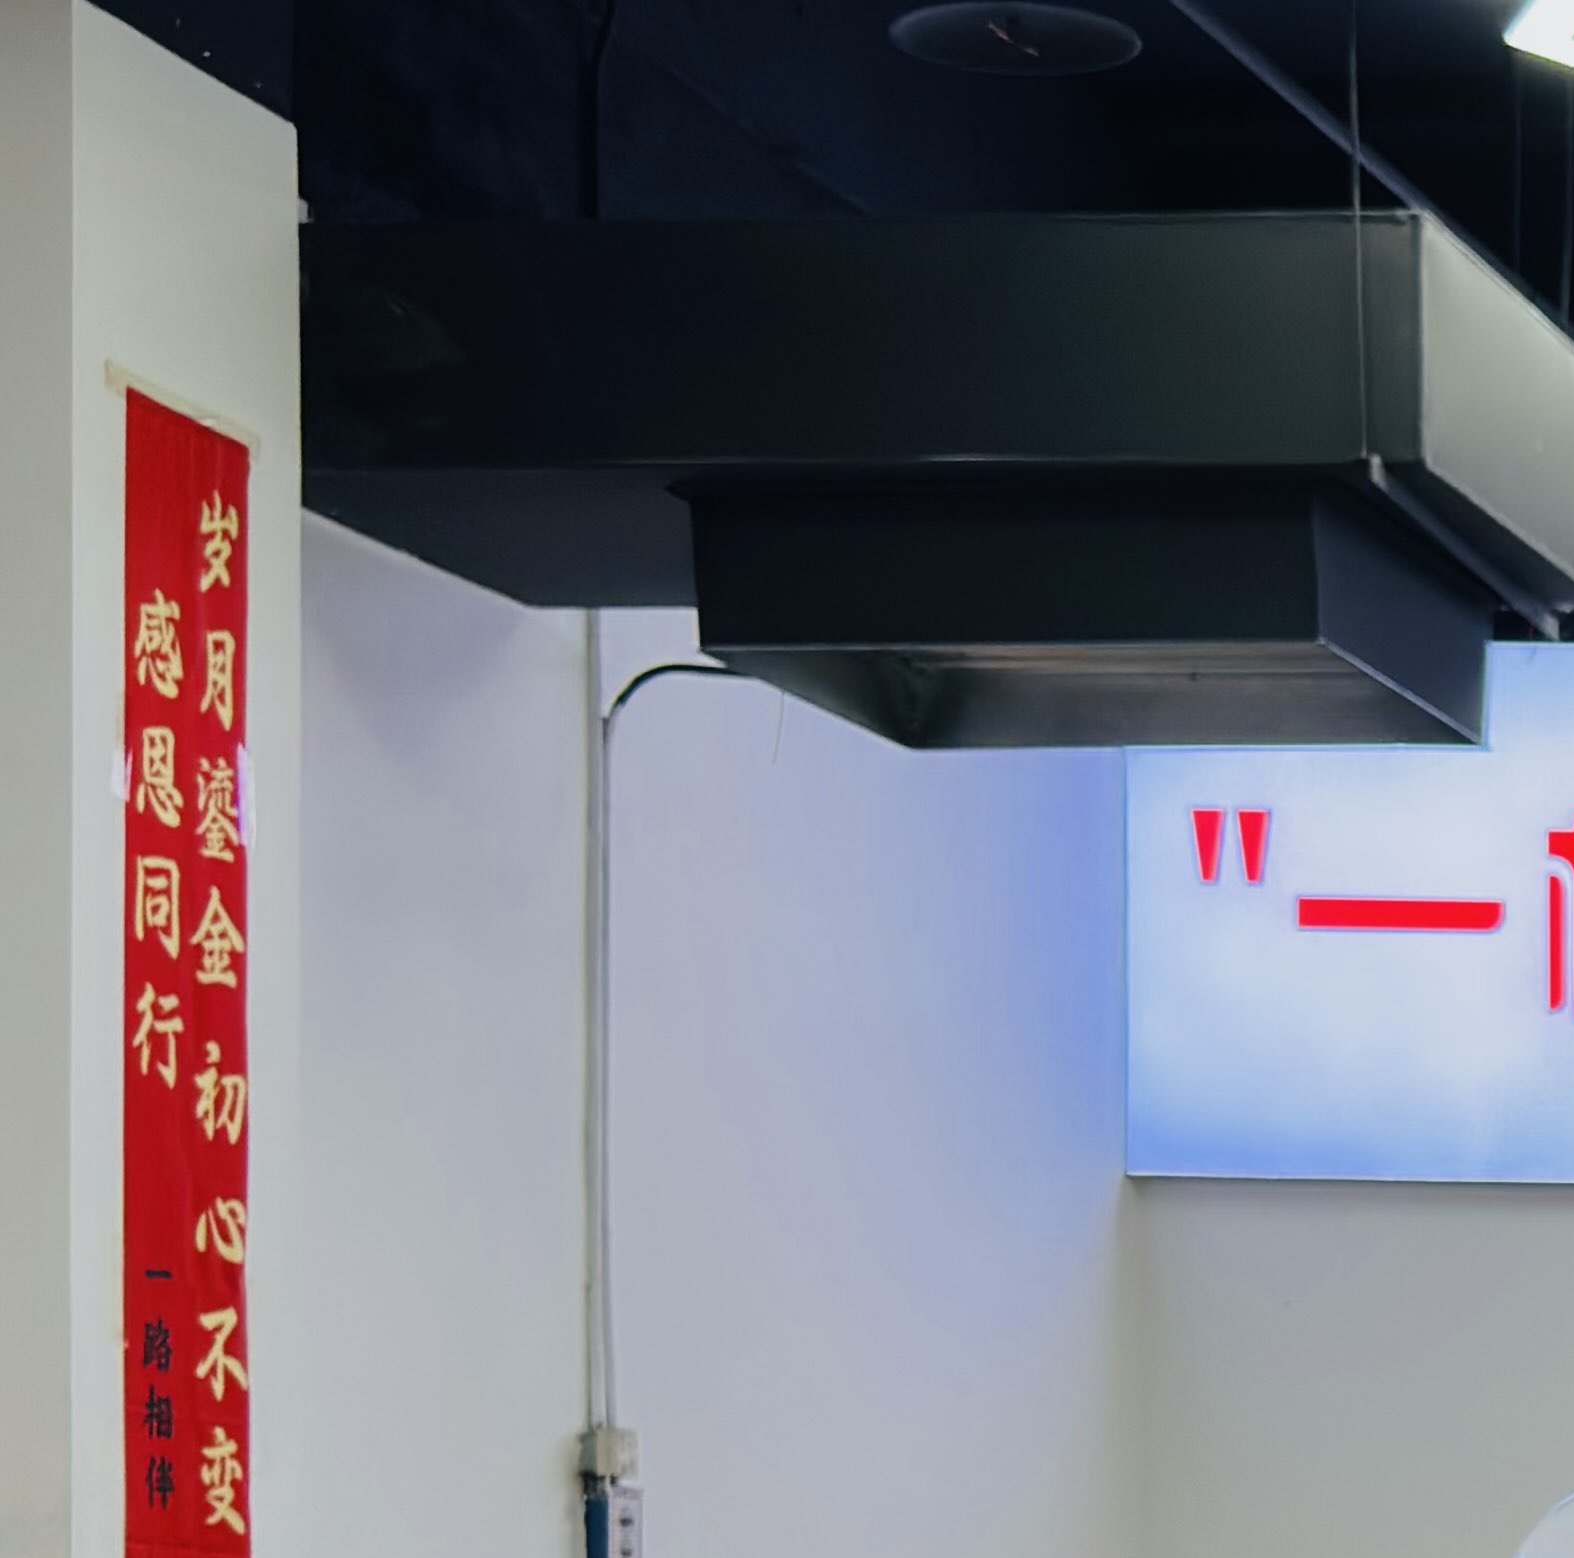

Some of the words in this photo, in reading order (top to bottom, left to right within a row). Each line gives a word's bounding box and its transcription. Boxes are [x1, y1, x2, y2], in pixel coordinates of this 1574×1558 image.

[134, 589, 183, 1088] 感恩同行
[143, 1268, 175, 1508] 一路相伴
